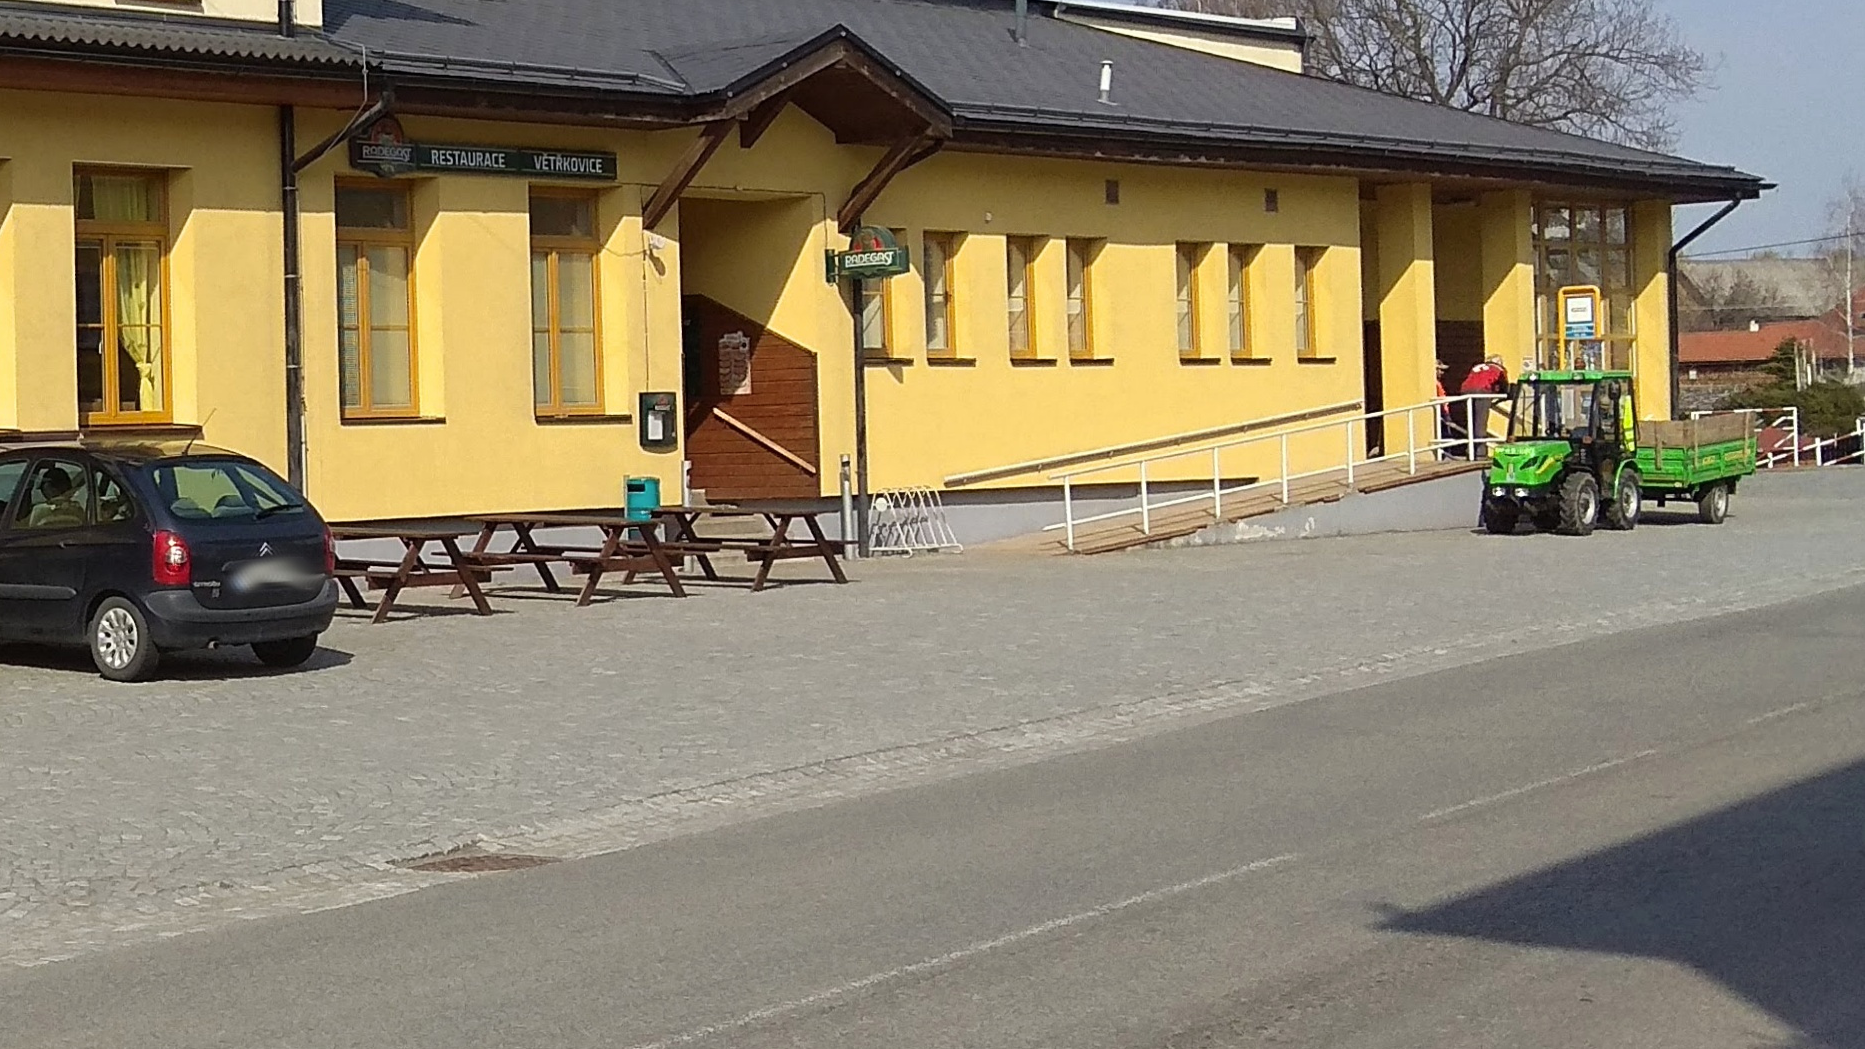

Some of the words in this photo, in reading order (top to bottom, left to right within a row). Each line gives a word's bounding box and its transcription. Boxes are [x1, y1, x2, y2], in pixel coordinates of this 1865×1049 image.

[362, 145, 412, 162] RADEGAST
[431, 150, 506, 168] RESTAURACE
[534, 152, 603, 173] VĚTŘKOVICE
[845, 251, 894, 268] RADEGAST
